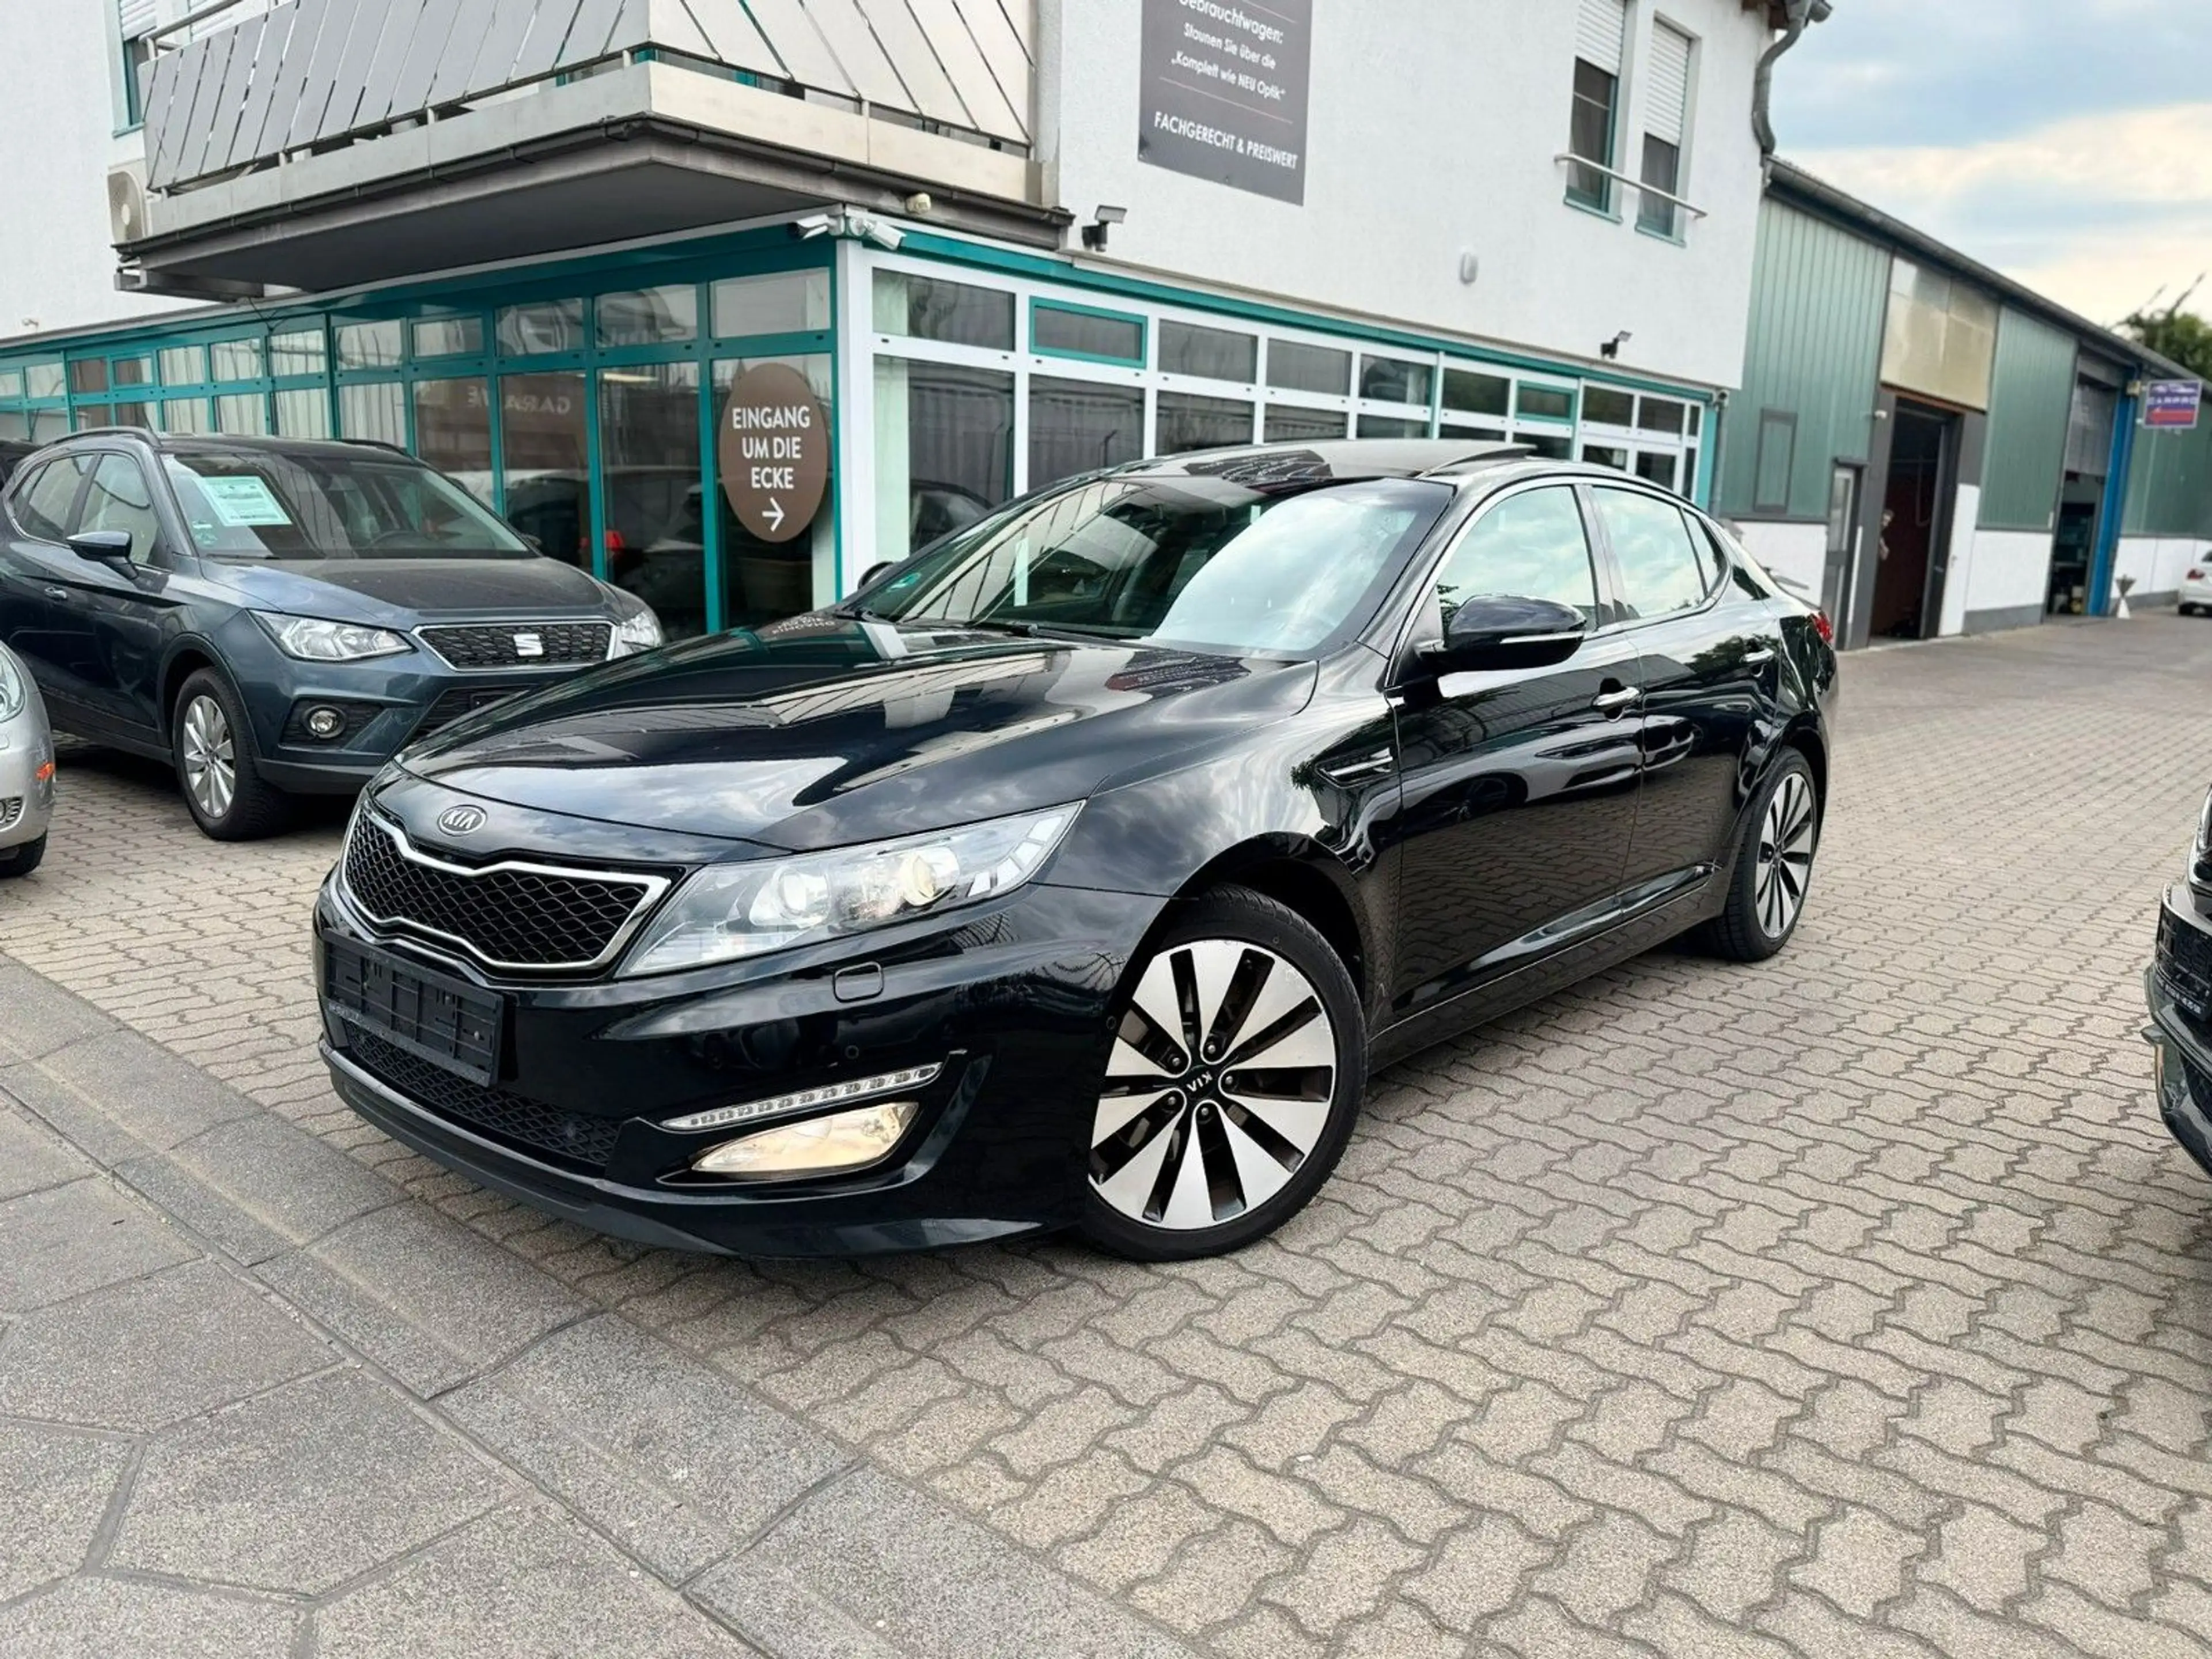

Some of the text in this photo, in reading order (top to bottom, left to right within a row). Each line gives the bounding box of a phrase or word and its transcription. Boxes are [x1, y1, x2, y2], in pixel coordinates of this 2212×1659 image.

[1184, 22, 1276, 69] Staunen Sie über die
[1220, 69, 1237, 85] wie
[1238, 73, 1257, 91] NEU
[1154, 111, 1298, 169] FACHGERECHT & PREISWERT
[732, 406, 811, 430] EINGANG
[742, 436, 802, 459] UM DIE
[751, 467, 794, 489] ECKE
[1186, 1070, 1213, 1092] KIA
